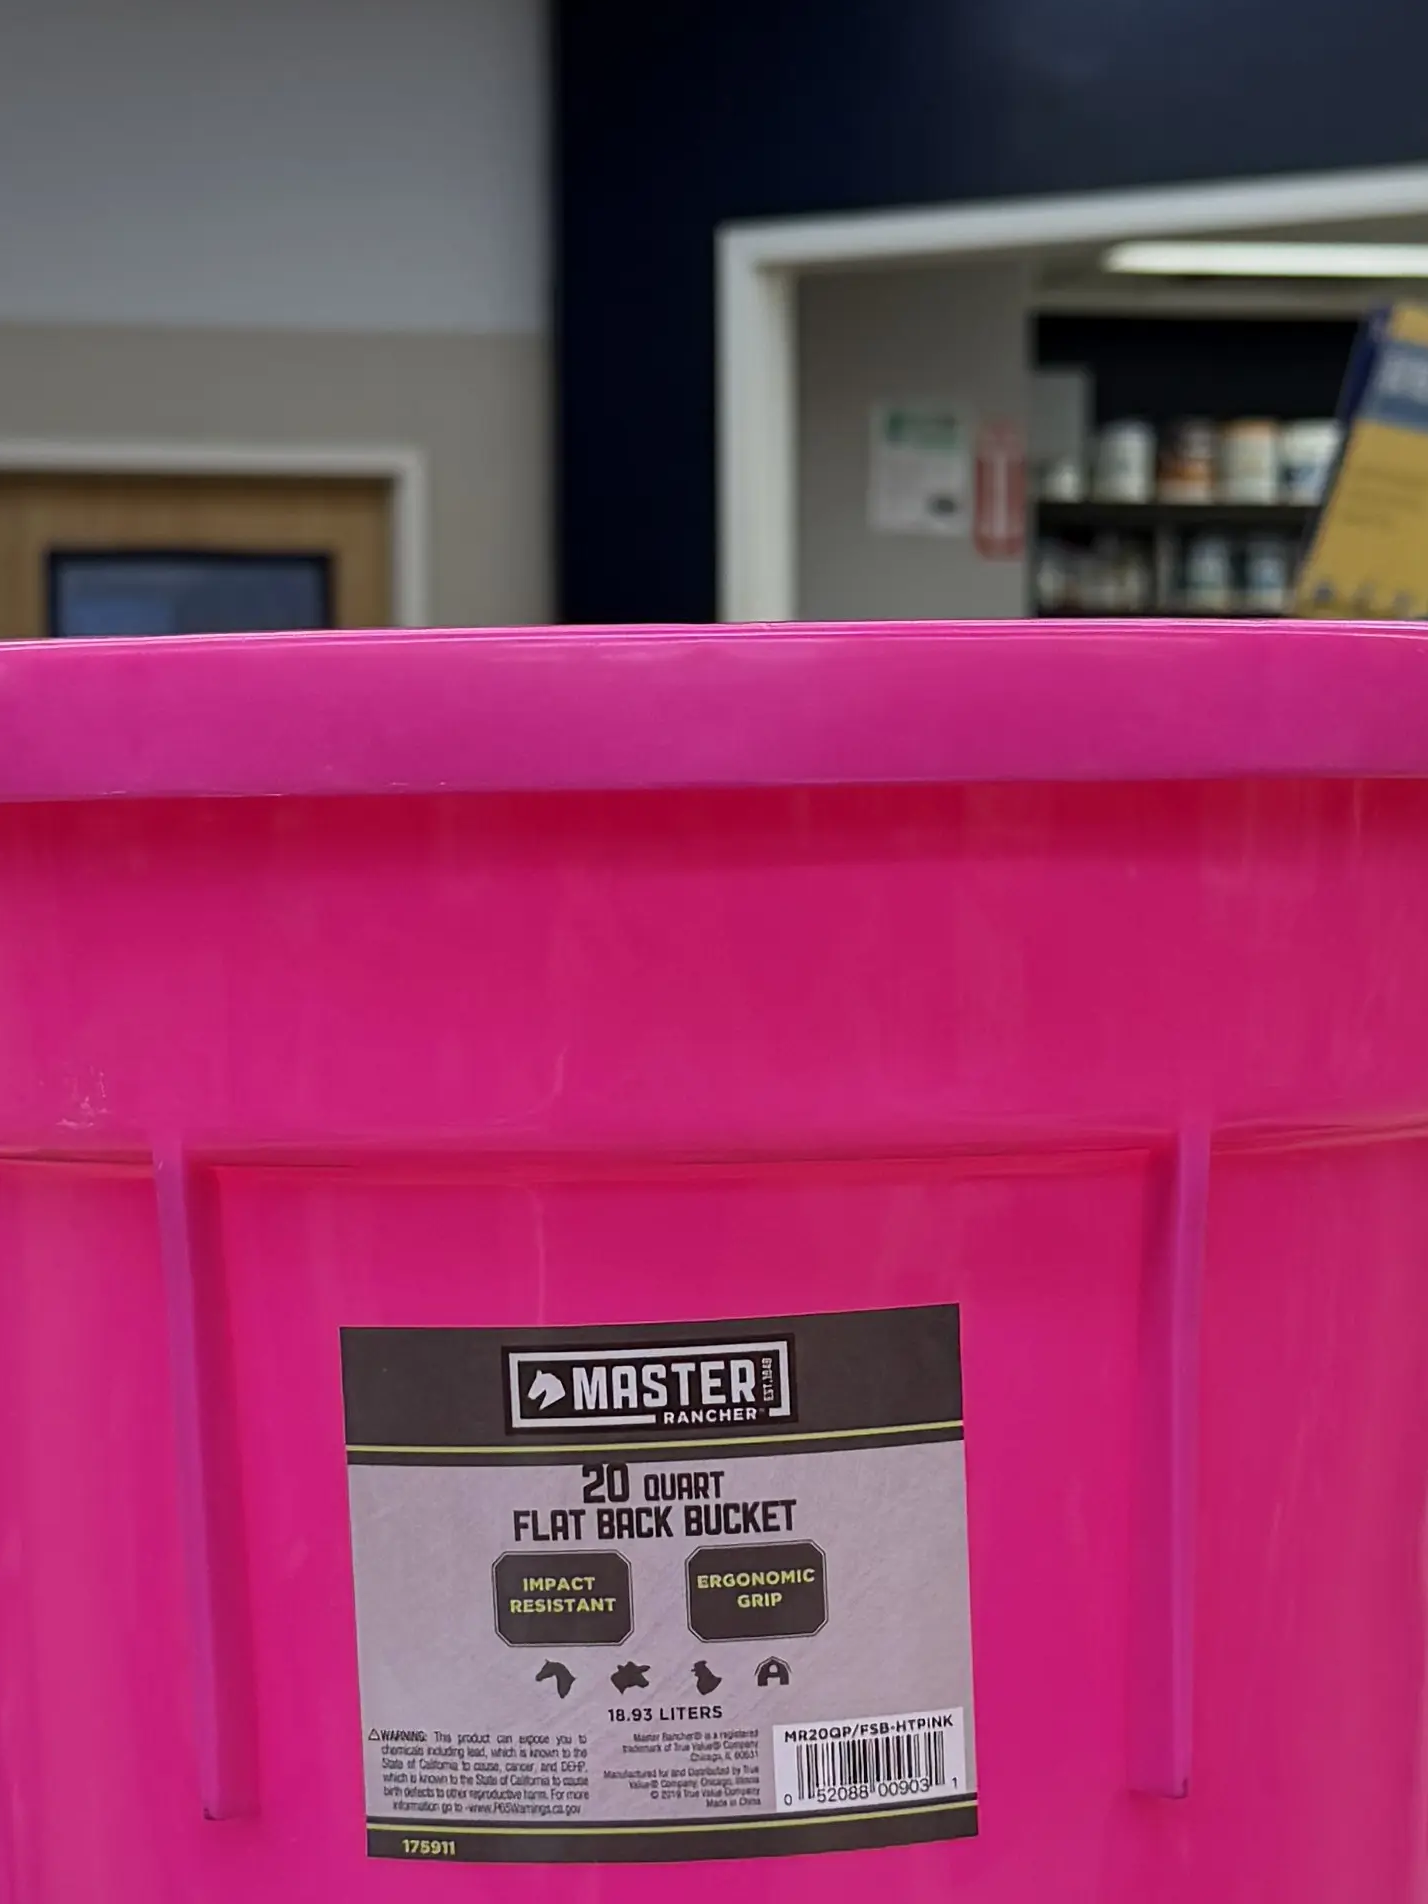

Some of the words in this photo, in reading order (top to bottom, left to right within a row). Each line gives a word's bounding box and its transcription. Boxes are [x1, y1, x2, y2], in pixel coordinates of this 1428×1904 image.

[572, 1359, 756, 1410] MASTER
[663, 1407, 757, 1425] RANCHER
[582, 1463, 630, 1503] 20
[644, 1471, 725, 1501] QUART
[513, 1509, 586, 1541] FLAT
[597, 1505, 673, 1539] BACK
[684, 1499, 797, 1536] BUCKET
[522, 1575, 596, 1593] IMPACT
[697, 1567, 816, 1589] ERGONOMIC
[509, 1597, 617, 1614] RESISTANT
[737, 1592, 783, 1609] GRIP
[608, 1708, 653, 1722] 18.93
[660, 1705, 723, 1721] LITERS
[784, 1713, 954, 1743] MR20QP/FSB-HTPINK
[380, 1729, 427, 1742] WARNING:
[434, 1730, 452, 1743] This
[457, 1733, 490, 1745] product
[497, 1734, 512, 1744] can
[556, 1735, 572, 1746] you
[578, 1734, 587, 1745] to
[427, 1746, 464, 1759] including
[491, 1747, 517, 1758] which
[529, 1747, 559, 1758] known
[562, 1747, 571, 1758] to
[573, 1747, 587, 1758] the
[664, 1743, 672, 1752] of
[674, 1742, 690, 1752] True
[382, 1757, 403, 1770] State
[419, 1758, 459, 1771] California
[462, 1760, 471, 1771] to
[540, 1761, 558, 1772] and
[671, 1768, 686, 1778] and
[731, 1766, 741, 1776] by
[382, 1772, 407, 1784] which
[419, 1772, 448, 1784] known
[450, 1773, 459, 1785] to
[460, 1774, 474, 1785] the
[475, 1773, 498, 1786] State
[499, 1774, 508, 1786] of
[510, 1774, 550, 1786] California
[552, 1775, 561, 1786] to
[436, 1788, 445, 1798] to
[550, 1788, 565, 1800] For
[566, 1790, 590, 1800] more
[683, 1788, 700, 1798] True
[784, 1793, 793, 1806] 0
[816, 1784, 869, 1804] 52088
[878, 1777, 930, 1797] 00903
[951, 1776, 959, 1789] 1
[441, 1802, 453, 1814] go
[454, 1802, 463, 1812] to
[705, 1798, 728, 1808] Made
[729, 1798, 737, 1807] in
[738, 1796, 761, 1807] China
[401, 1838, 457, 1856] 175911
